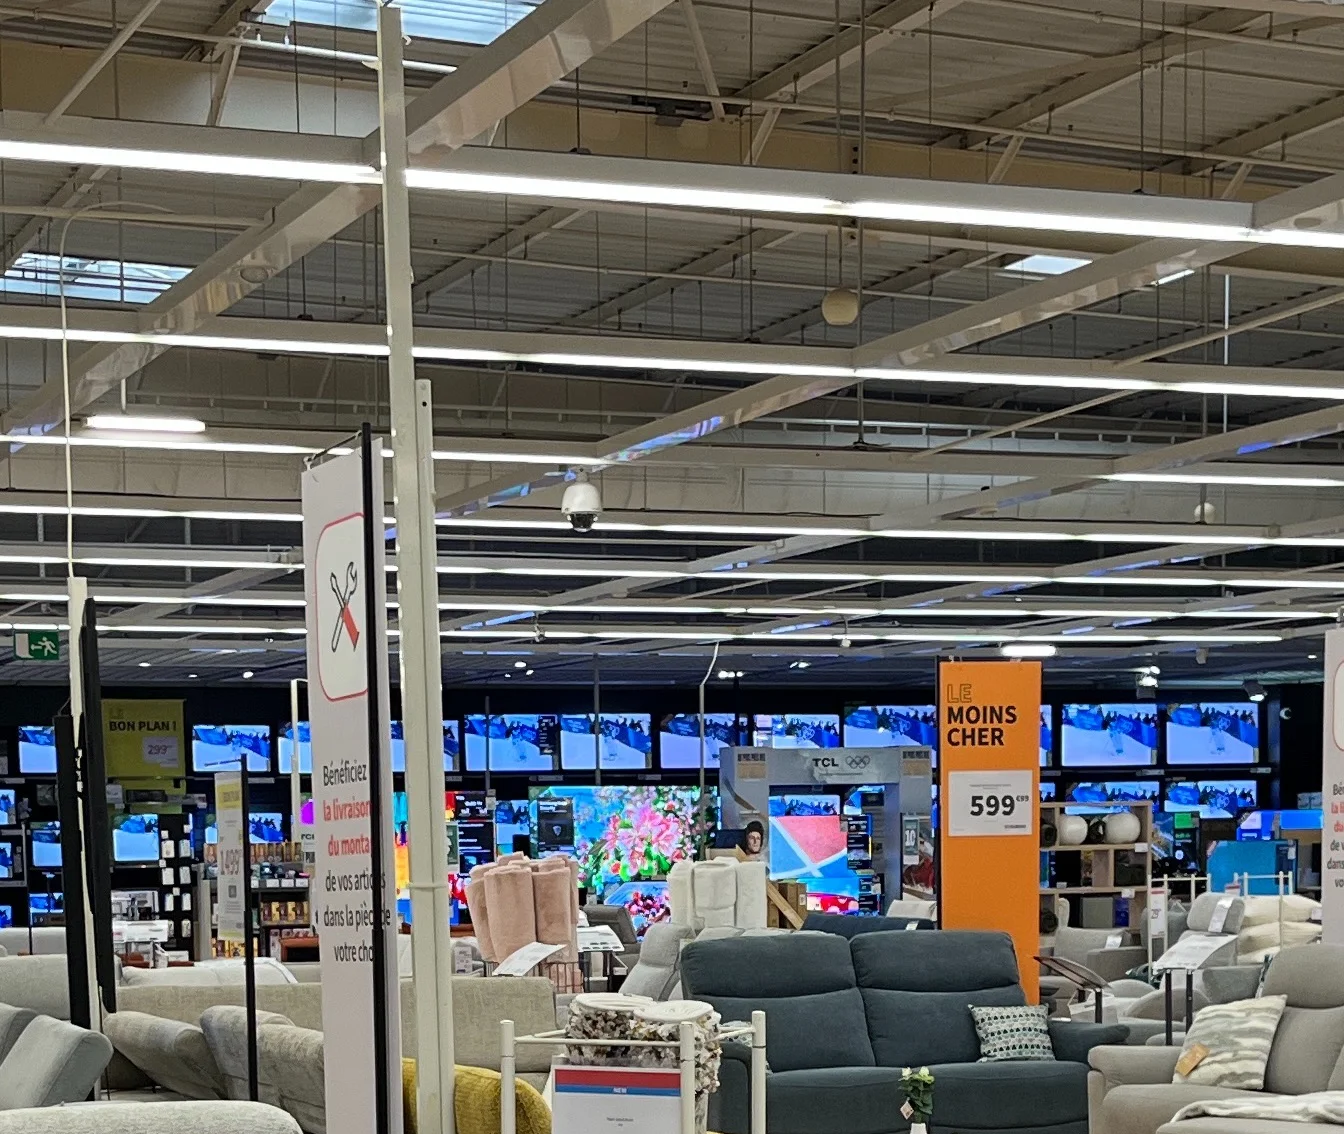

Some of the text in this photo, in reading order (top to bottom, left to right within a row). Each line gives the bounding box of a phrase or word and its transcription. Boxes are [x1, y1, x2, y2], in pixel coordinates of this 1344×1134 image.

[946, 683, 972, 703] LE
[947, 705, 1018, 725] MOINS
[109, 720, 170, 732] BON PLAN
[947, 727, 1005, 747] CHER
[323, 759, 368, 786] Bénéficiez
[812, 757, 839, 768] TCL
[341, 834, 370, 857] monta
[325, 869, 337, 892] de
[338, 873, 353, 892] vos
[324, 905, 345, 928] dans
[345, 904, 354, 927] la
[355, 900, 375, 932] pièc
[333, 943, 357, 962] votre
